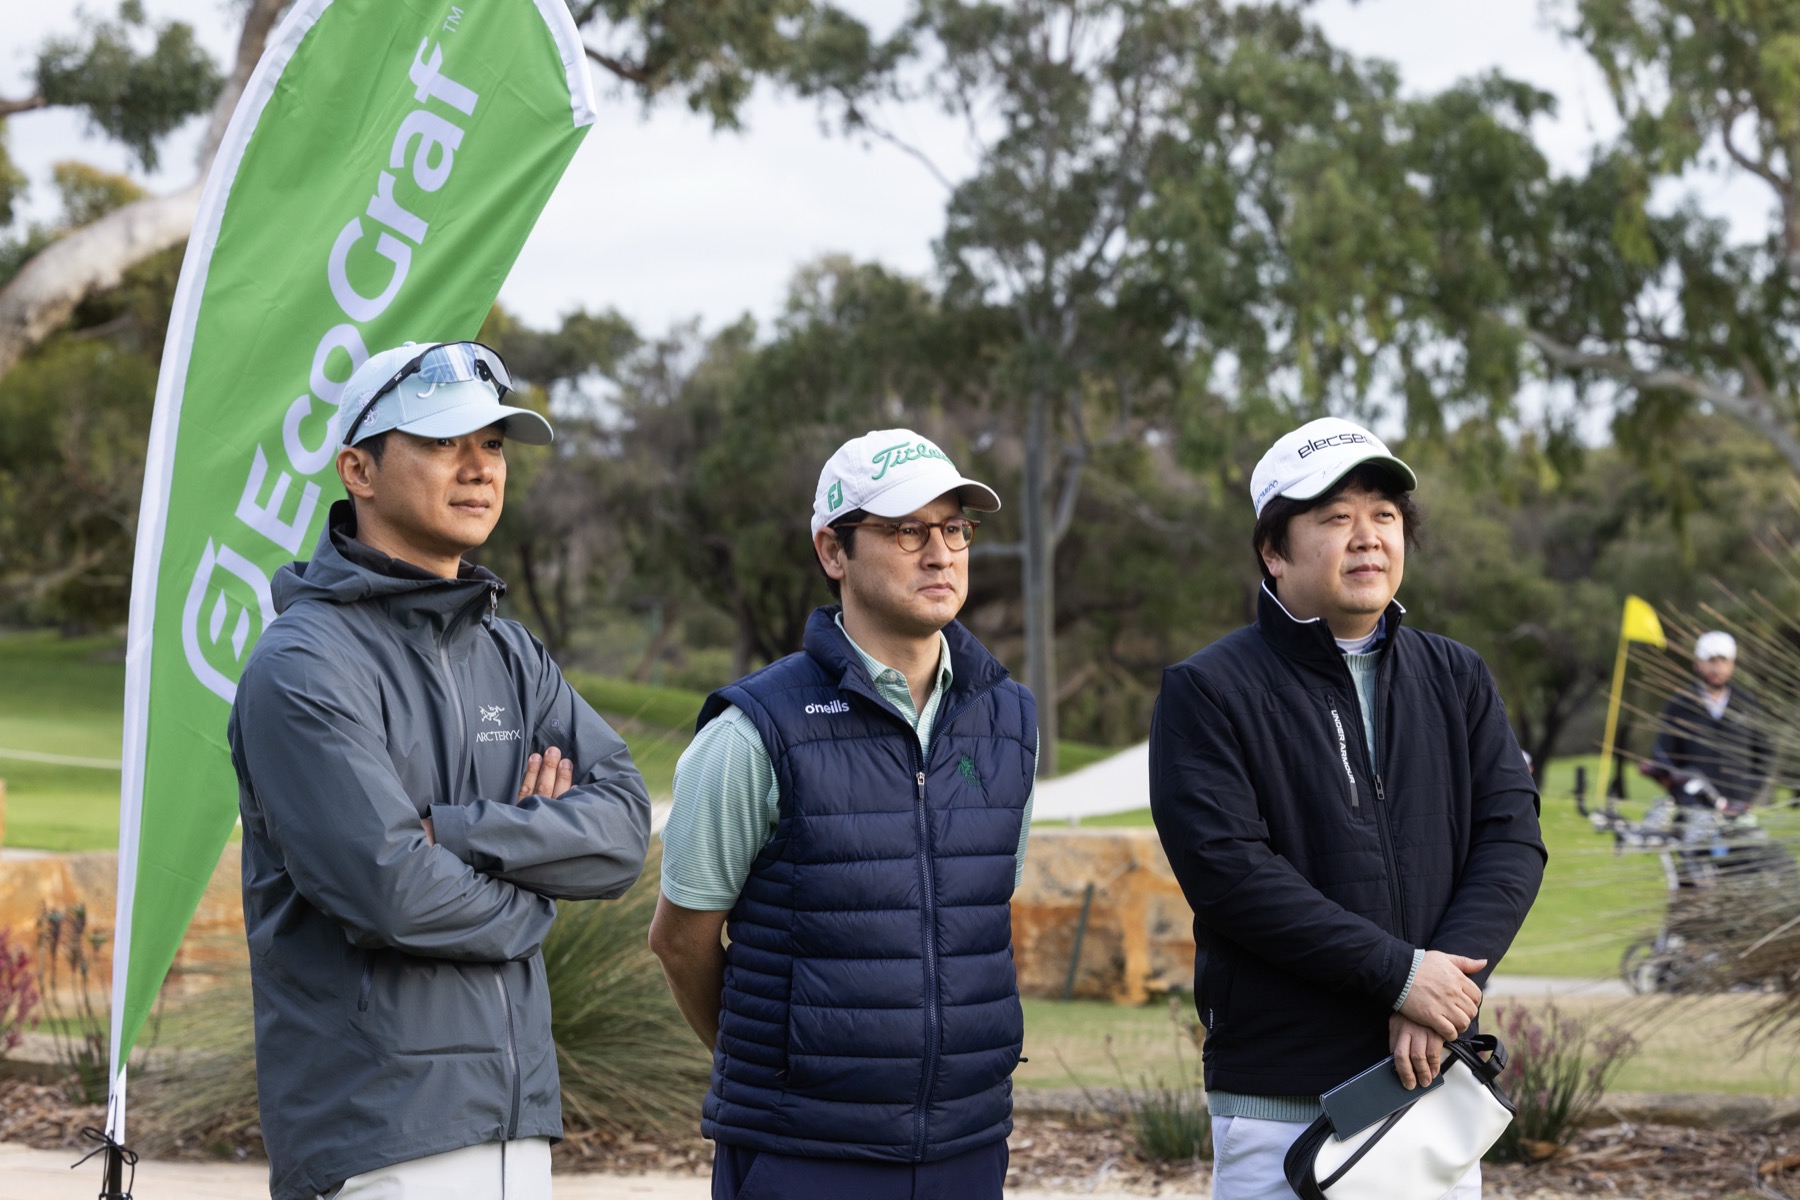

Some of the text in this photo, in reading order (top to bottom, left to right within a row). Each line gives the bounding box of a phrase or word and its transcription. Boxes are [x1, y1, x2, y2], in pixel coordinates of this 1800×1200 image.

[236, 36, 479, 556] EcoGraf
[1331, 709, 1355, 784] UNDER ARMOUR
